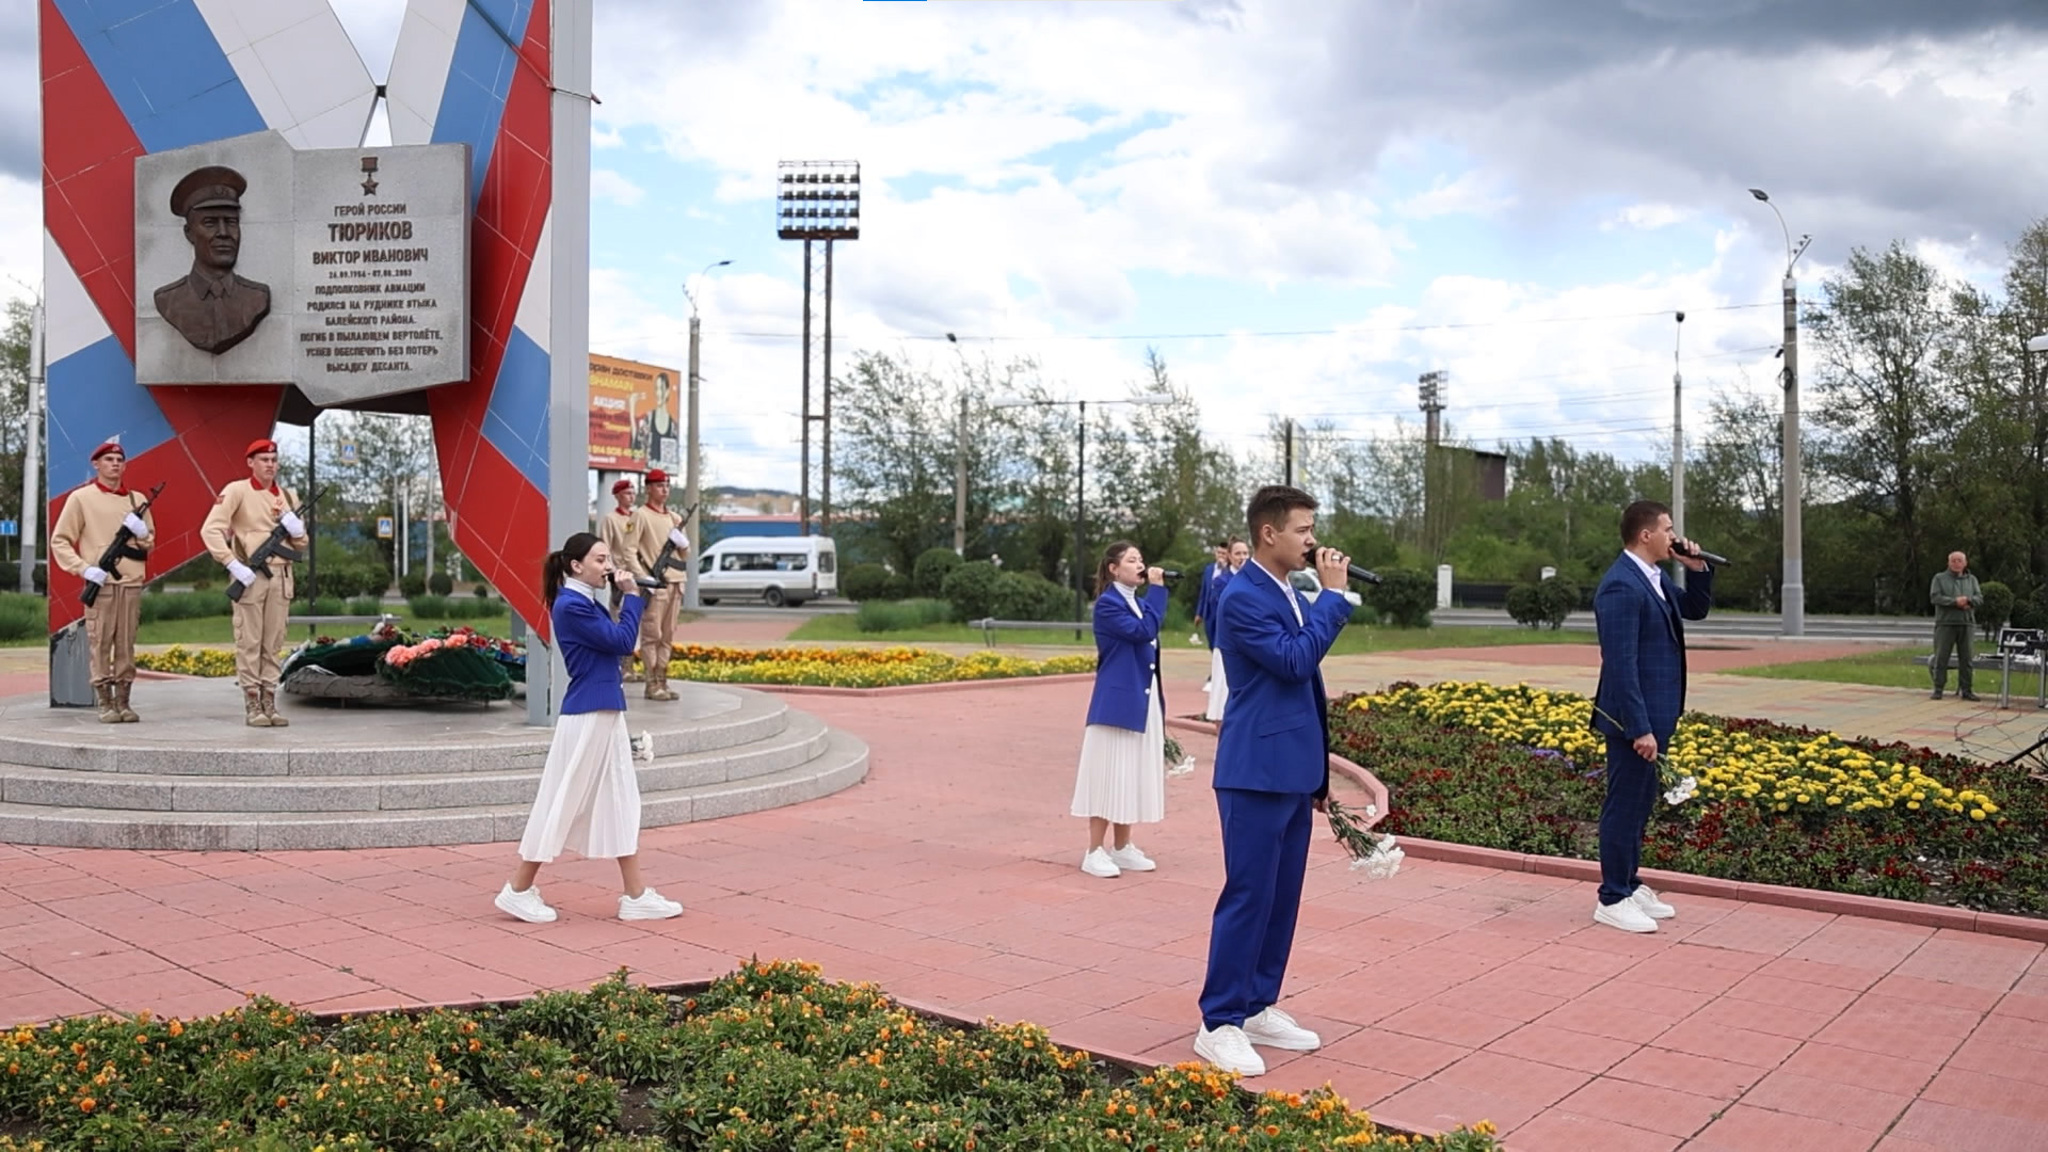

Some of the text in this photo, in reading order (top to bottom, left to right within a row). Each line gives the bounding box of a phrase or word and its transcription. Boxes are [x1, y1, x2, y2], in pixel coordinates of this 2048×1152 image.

[335, 202, 406, 216] ГЕРОЙ РОССИИ
[328, 221, 412, 242] ТЮРИКОВ
[313, 248, 428, 264] ВИКТОР ИВАНОВИЧ
[315, 283, 426, 296] ПОДПОЛКОВНИК АВИАЦИИ
[307, 301, 346, 311] РОДИЛСЯ
[350, 300, 360, 310] НА
[364, 300, 403, 310] РУДНИКЕ
[325, 314, 378, 326] БАЛЕЙСКОГО
[300, 332, 327, 342] ПОГИБ
[329, 332, 334, 341] В
[337, 331, 390, 342] ПЫЛАЮЩЕМ
[306, 346, 438, 357] УСПЕВ ОБЕСПЕЧИТЬ БЕЗ ПОТЕРЬ
[326, 363, 368, 373] ВЫСАДКУ
